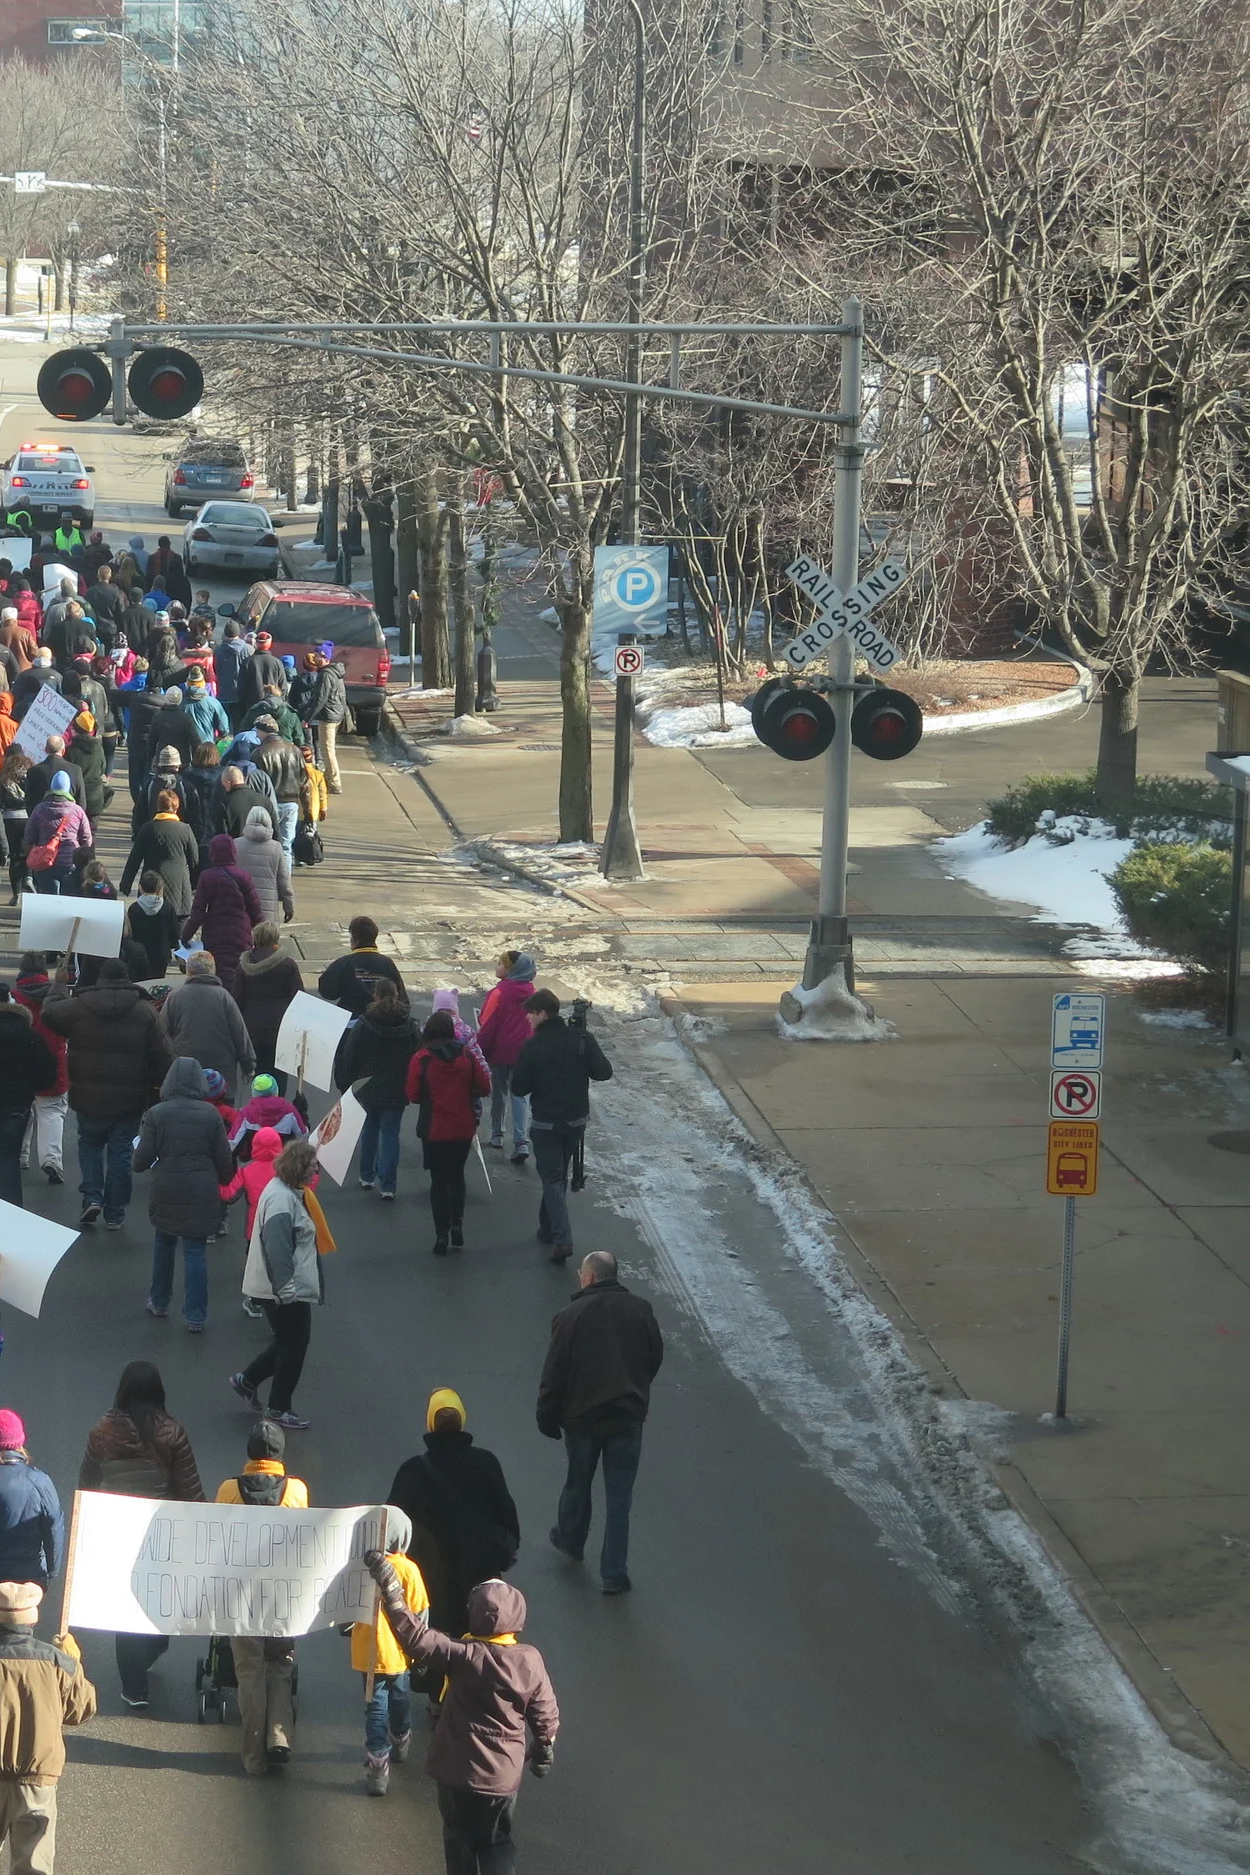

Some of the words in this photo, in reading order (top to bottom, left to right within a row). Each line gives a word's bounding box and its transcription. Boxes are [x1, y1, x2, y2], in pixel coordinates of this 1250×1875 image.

[601, 551, 651, 604] PARK
[789, 564, 900, 664] CROSSING
[791, 560, 835, 609] RAIL
[848, 619, 894, 667] ROAD
[37, 686, 57, 711] 300
[1053, 1140, 1069, 1148] CITY
[1073, 1141, 1093, 1149] LINES
[195, 1520, 339, 1568] DEVELOPMENT
[146, 1572, 254, 1619] FONDATION
[260, 1578, 302, 1620] FOR
[313, 1569, 371, 1617] PEACE
